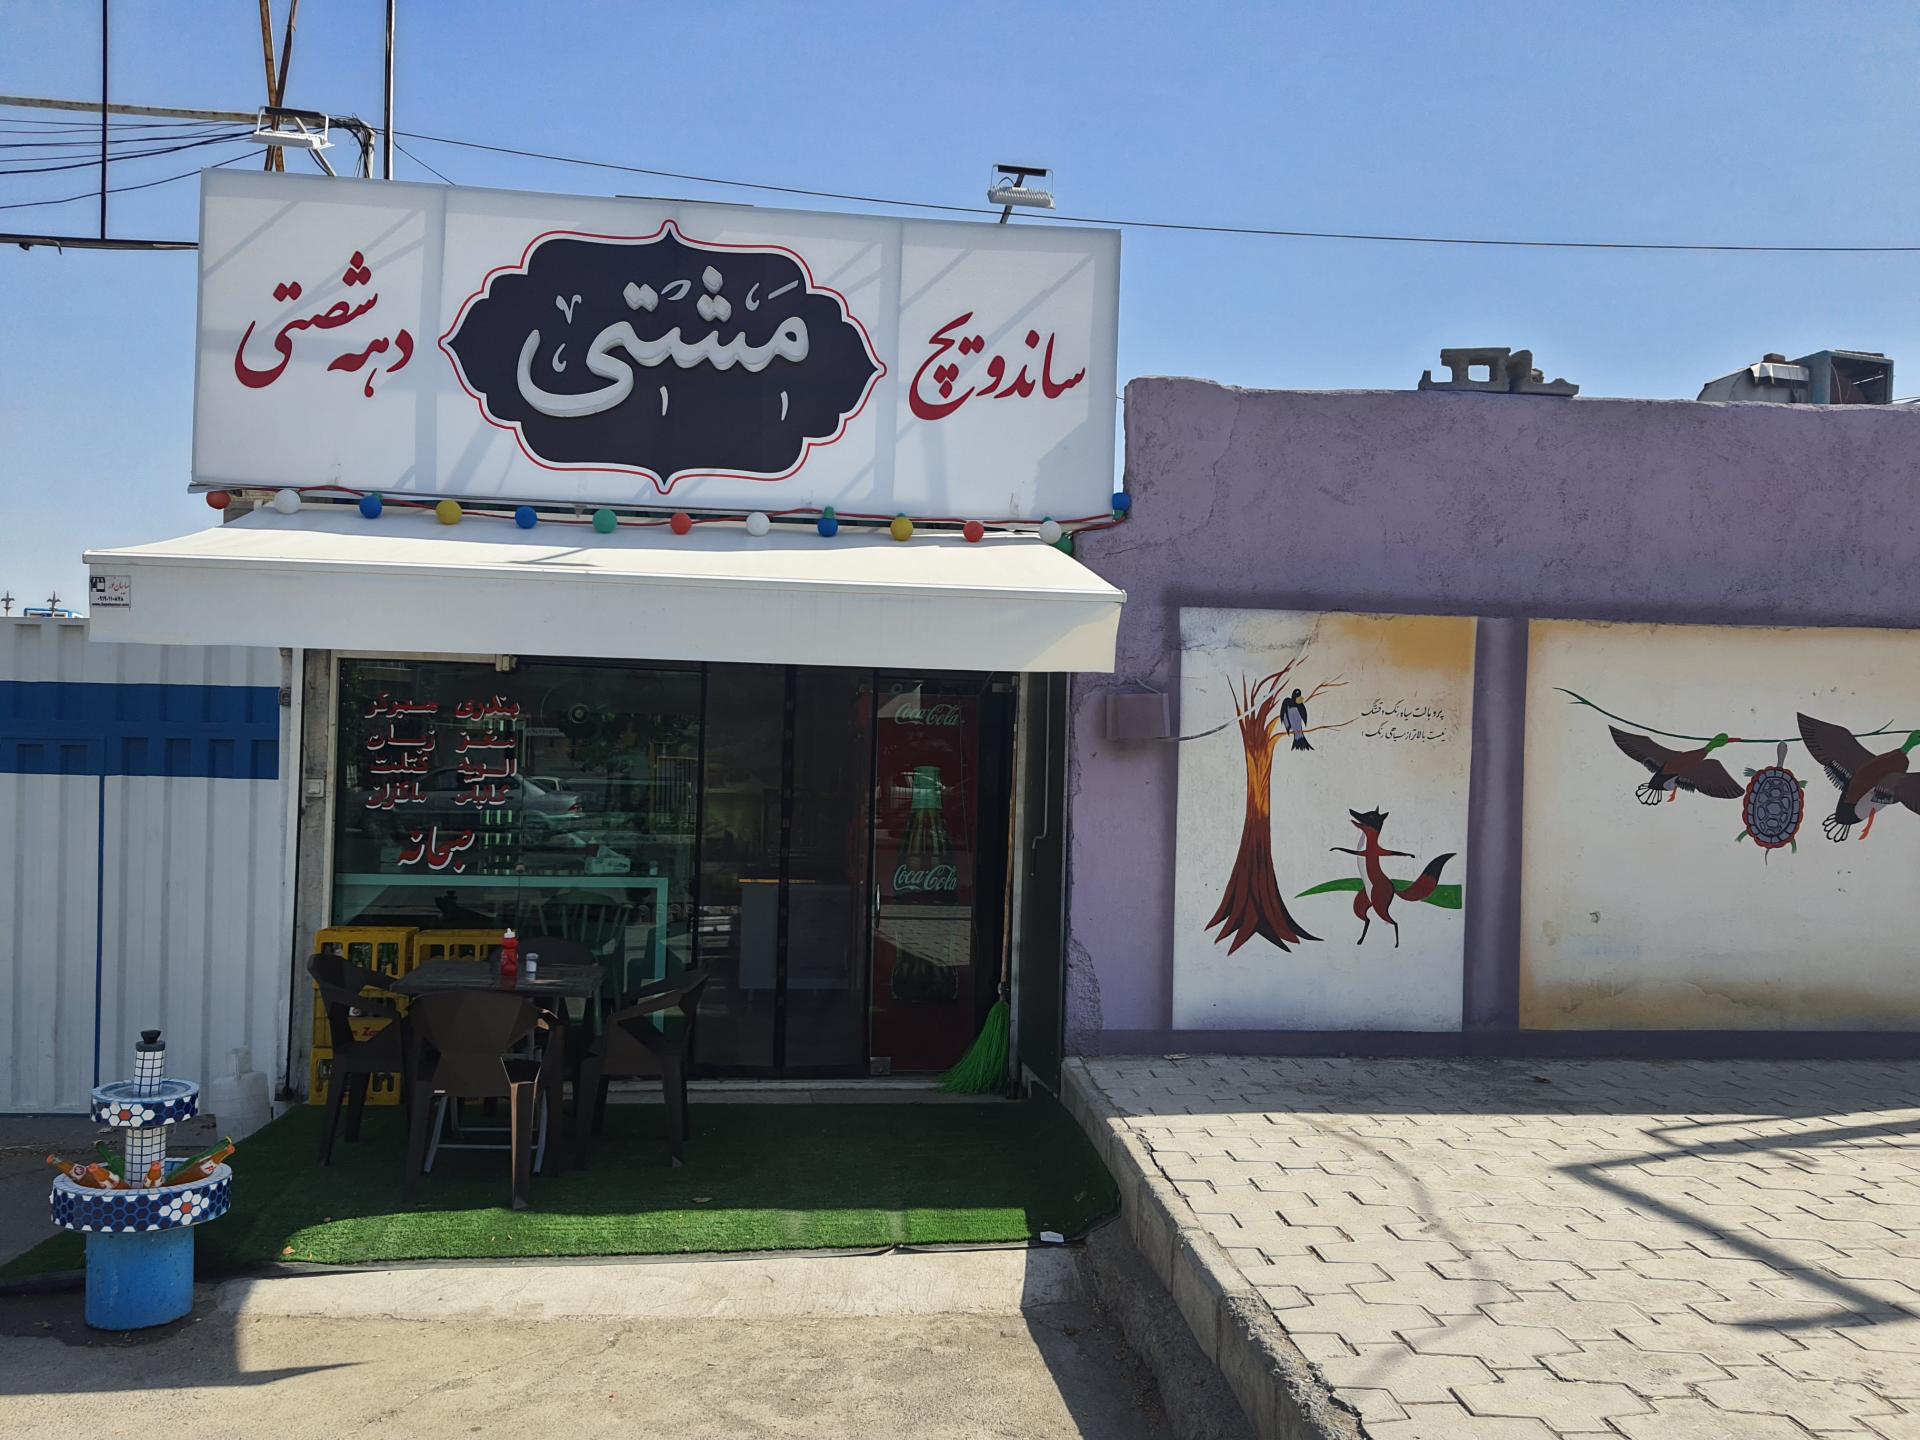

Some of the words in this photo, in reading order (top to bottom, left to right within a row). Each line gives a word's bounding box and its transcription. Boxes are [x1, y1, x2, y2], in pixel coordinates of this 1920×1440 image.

[233, 250, 379, 389] شصتی
[327, 328, 415, 399] دهه
[908, 311, 1086, 421] ساندویچ
[454, 694, 521, 722] بندری
[366, 721, 436, 754] زبان
[454, 730, 517, 754] مغز
[367, 751, 431, 774] کتلت
[455, 756, 518, 784] الویه
[396, 825, 476, 874] صبحانه
[893, 863, 959, 891] Coca-Cola
